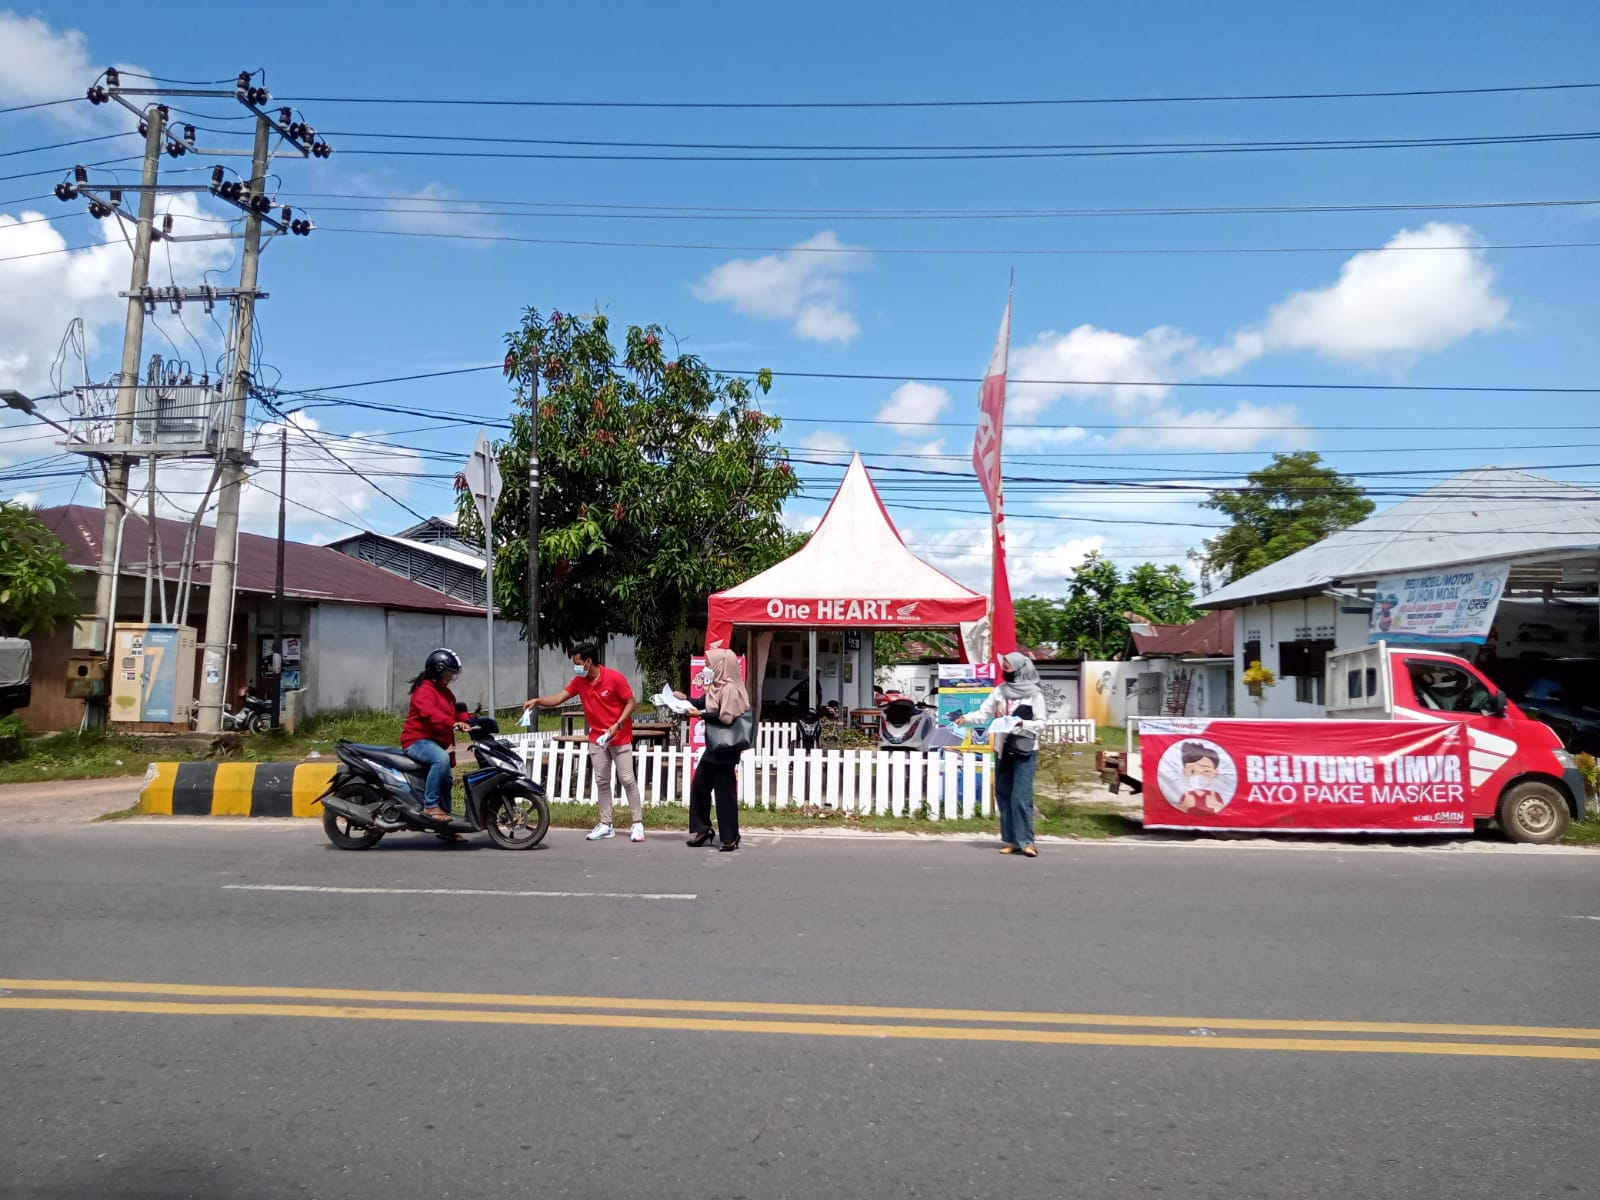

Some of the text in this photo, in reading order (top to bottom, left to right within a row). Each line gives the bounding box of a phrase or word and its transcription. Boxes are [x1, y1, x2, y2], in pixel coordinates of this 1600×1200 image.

[766, 599, 893, 621] One HEART.
[1247, 754, 1461, 784] BELITUNG TIMUR
[1248, 785, 1465, 805] AYO PAKE MASKER
